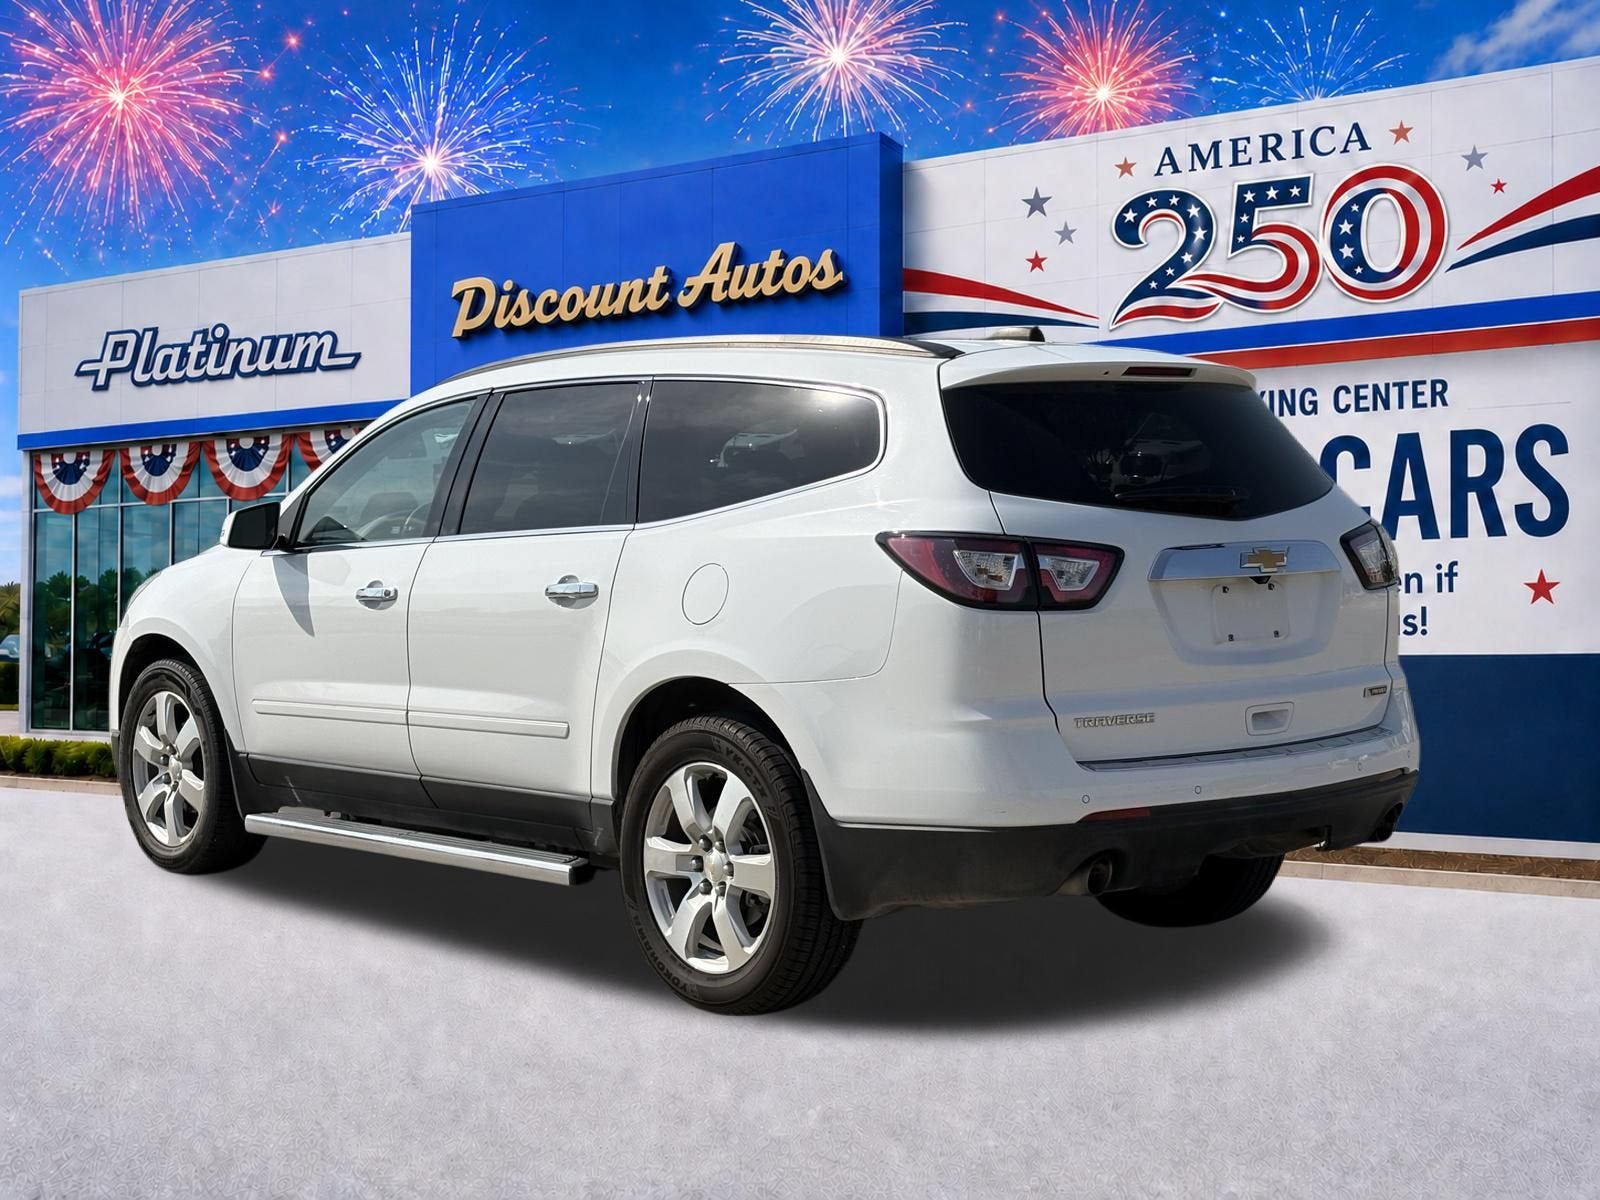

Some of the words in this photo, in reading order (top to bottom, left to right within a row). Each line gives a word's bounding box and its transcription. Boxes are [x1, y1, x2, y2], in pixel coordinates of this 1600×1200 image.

[1154, 122, 1372, 177] AMERICA
[1110, 164, 1449, 331] 250
[451, 265, 671, 338] Discount
[677, 241, 844, 309] Autos
[74, 323, 362, 391] Platinum
[1260, 387, 1318, 417] ING
[1333, 378, 1449, 415] CENTER
[1319, 423, 1570, 541] CARS
[1436, 561, 1458, 593] if
[1074, 712, 1155, 728] TRAVERSE
